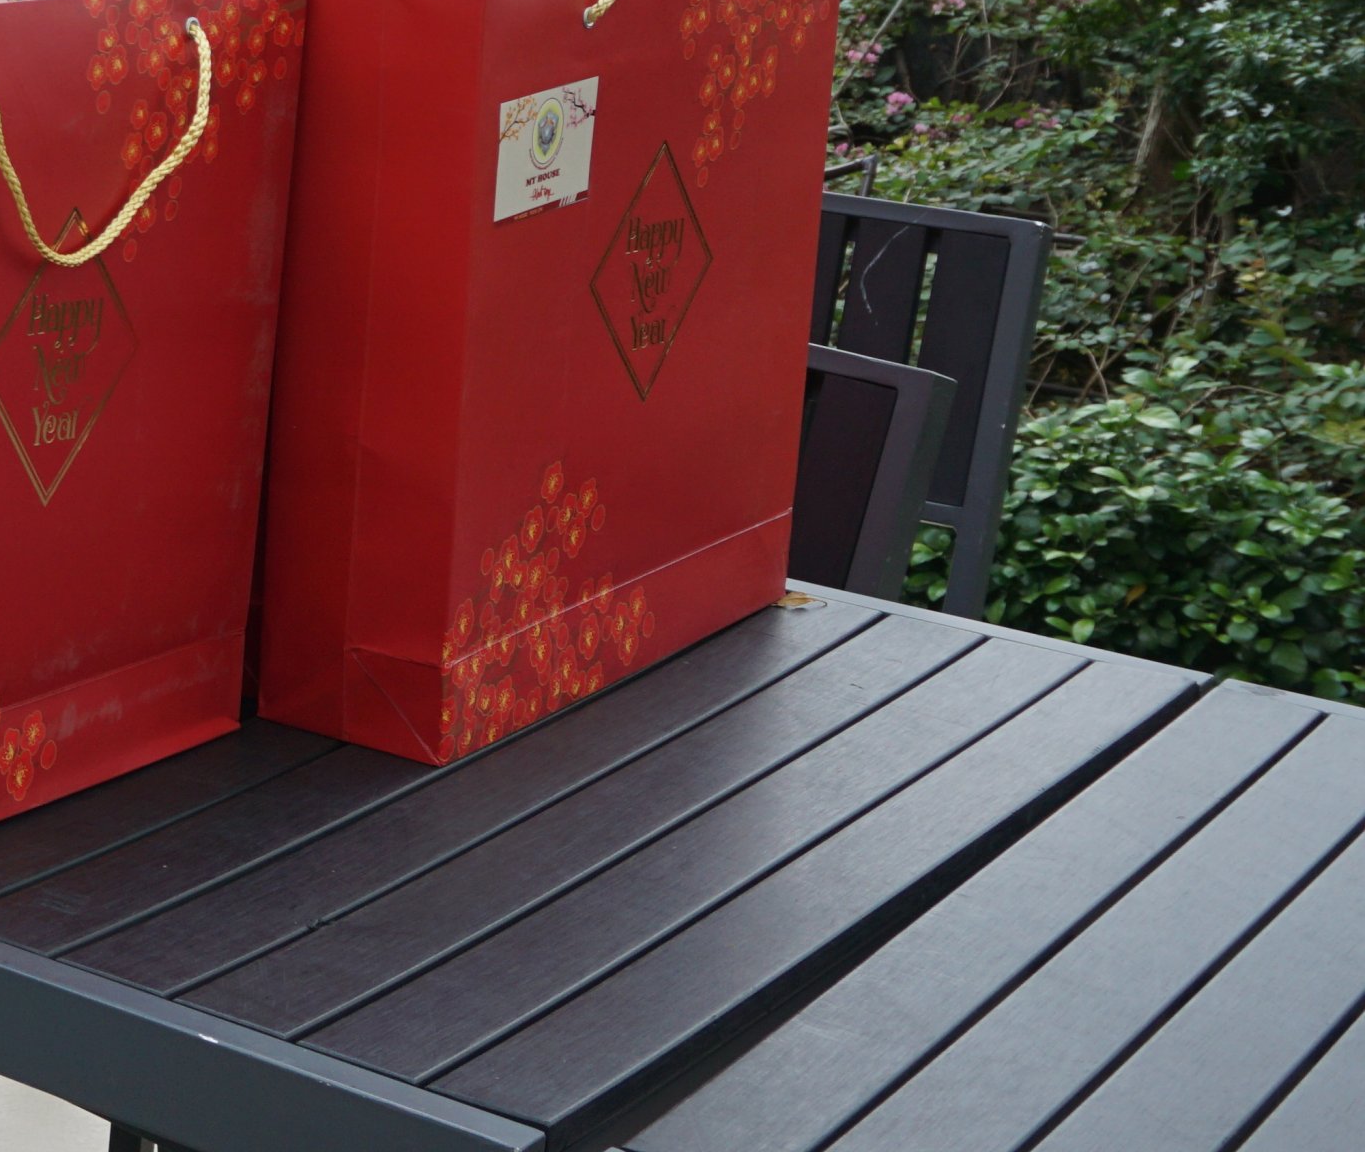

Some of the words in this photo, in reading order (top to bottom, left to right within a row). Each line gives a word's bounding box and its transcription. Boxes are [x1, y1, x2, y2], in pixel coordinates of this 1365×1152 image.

[525, 176, 537, 187] MY
[537, 168, 561, 183] HOUSE
[625, 217, 685, 266] Happy
[629, 261, 671, 313] New
[27, 294, 105, 354] Happy
[630, 315, 666, 351] Year
[32, 346, 87, 405] New
[32, 401, 79, 446] Year
